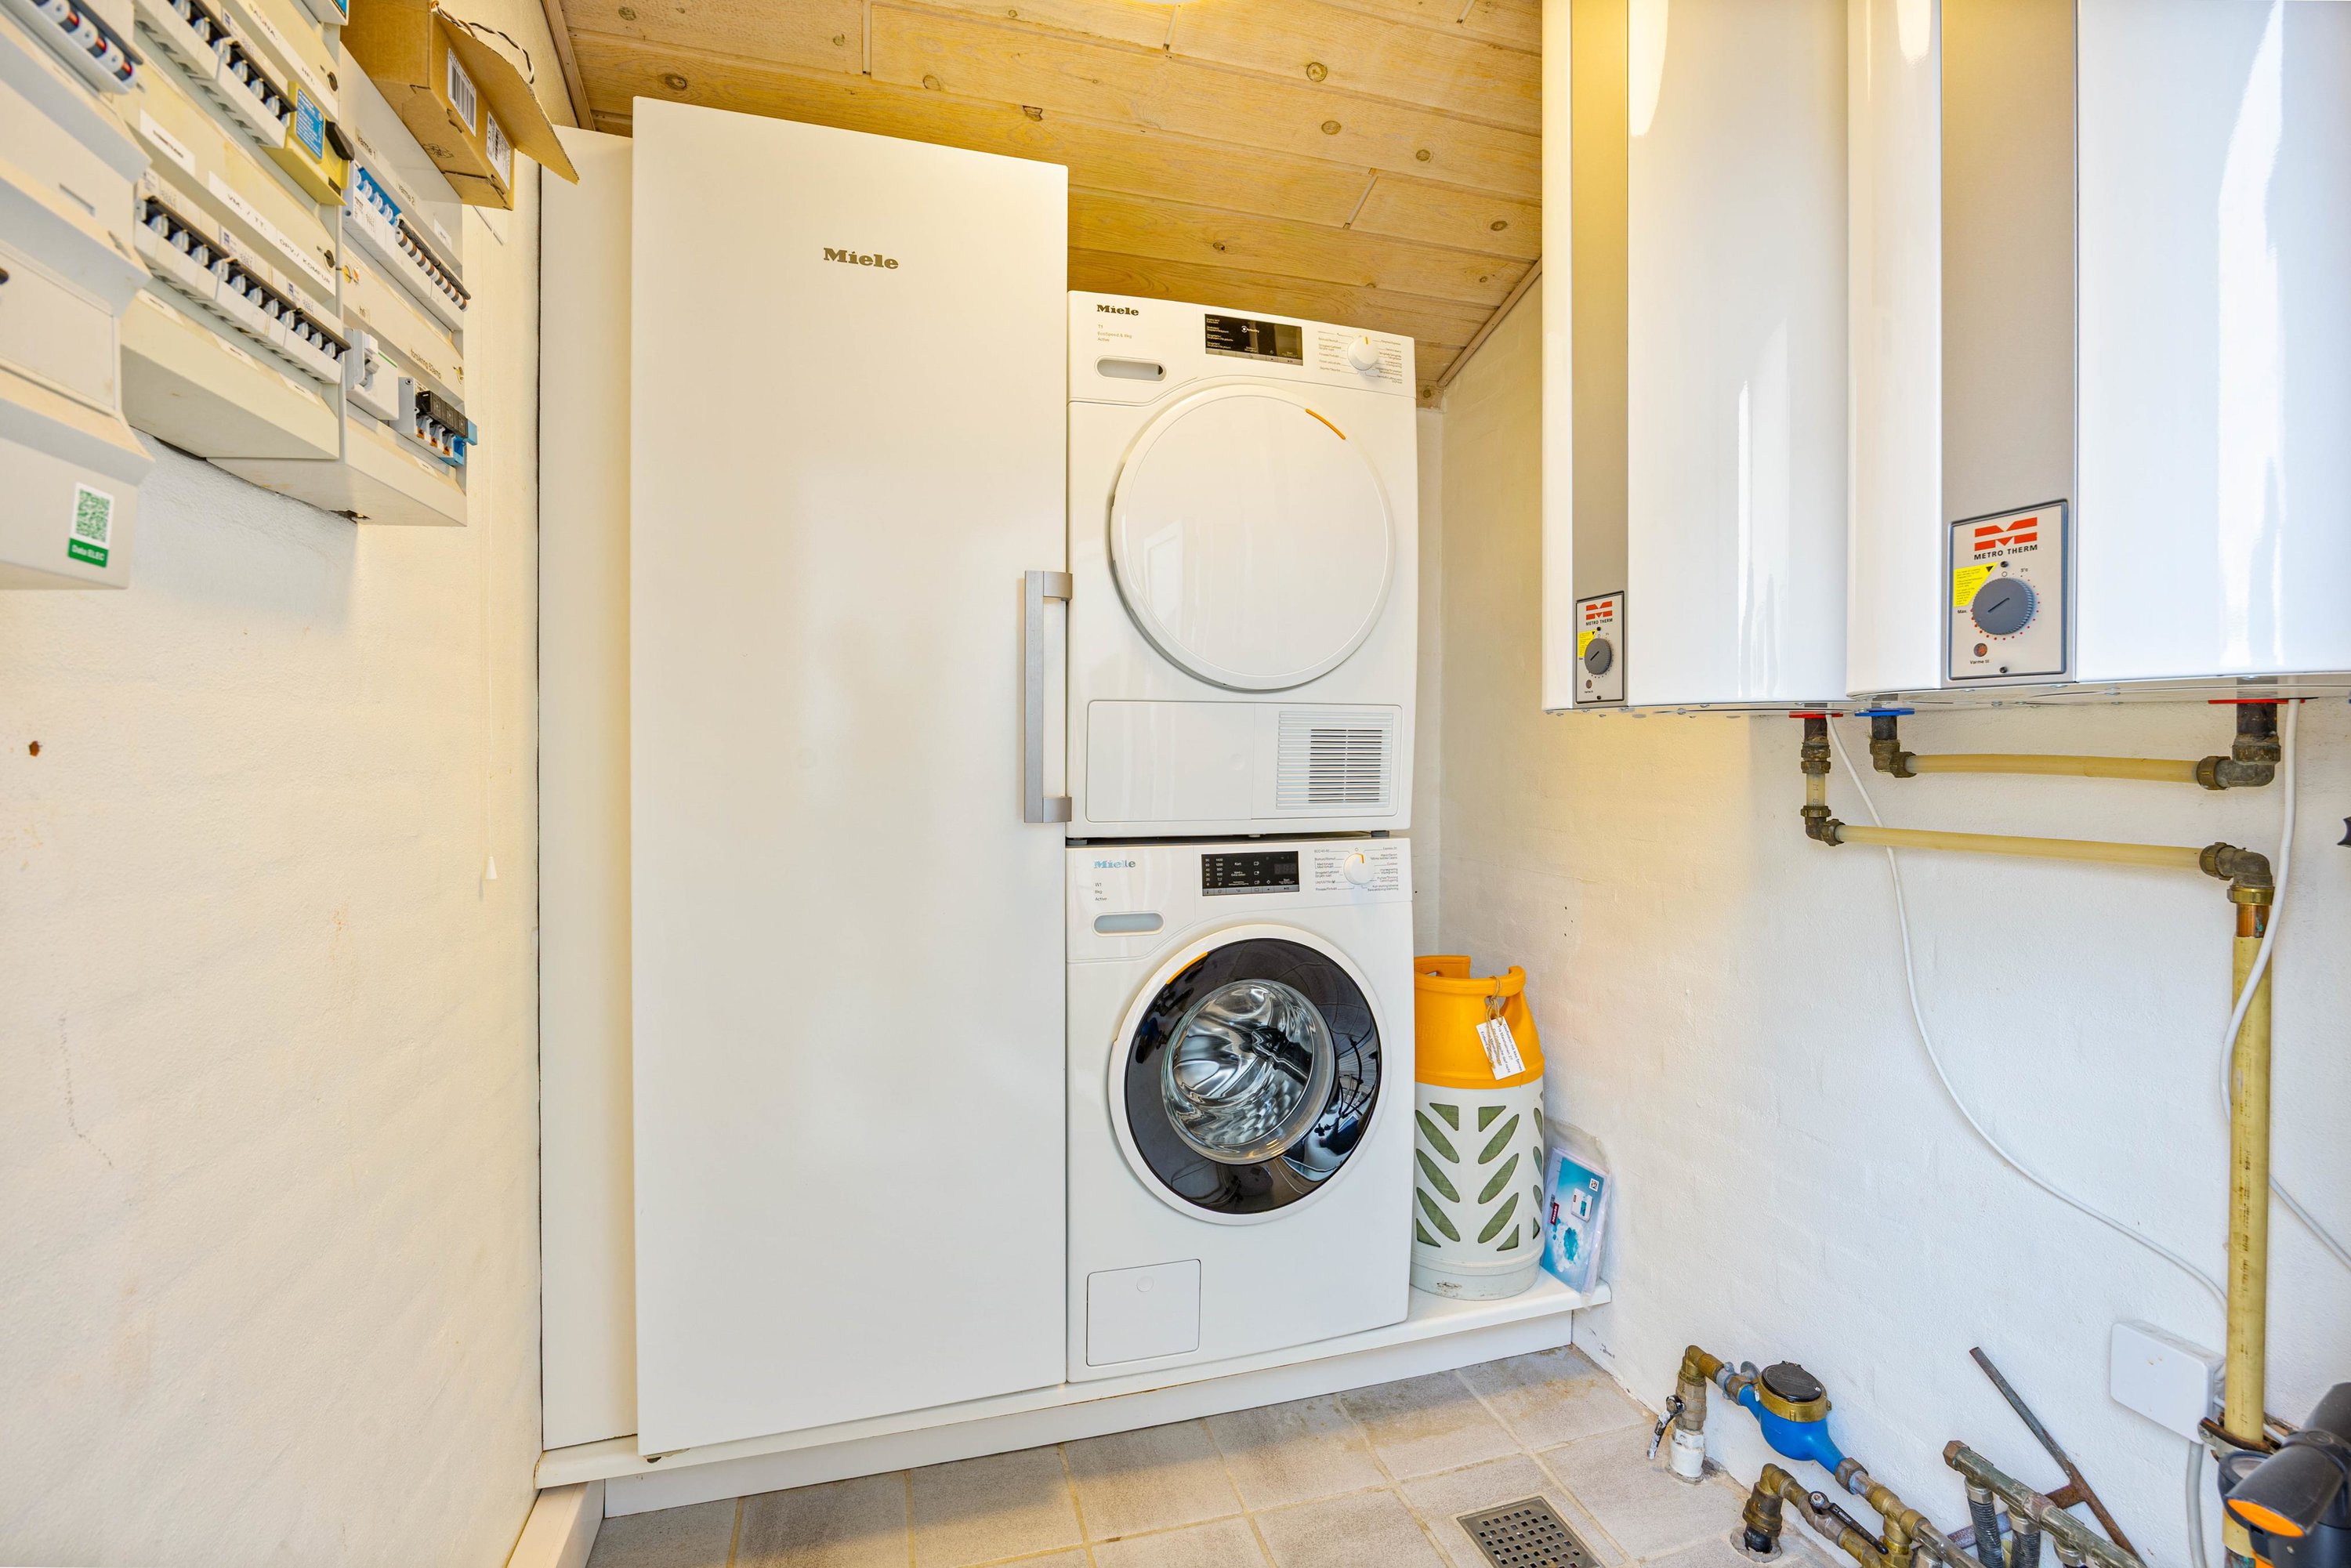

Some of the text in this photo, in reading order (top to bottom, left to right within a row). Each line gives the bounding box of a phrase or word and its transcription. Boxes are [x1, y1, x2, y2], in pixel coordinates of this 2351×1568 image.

[823, 248, 899, 270] Miele
[1097, 305, 1139, 316] Miele
[1974, 544, 2038, 560] METRO THERM
[1094, 860, 1136, 868] Miele
